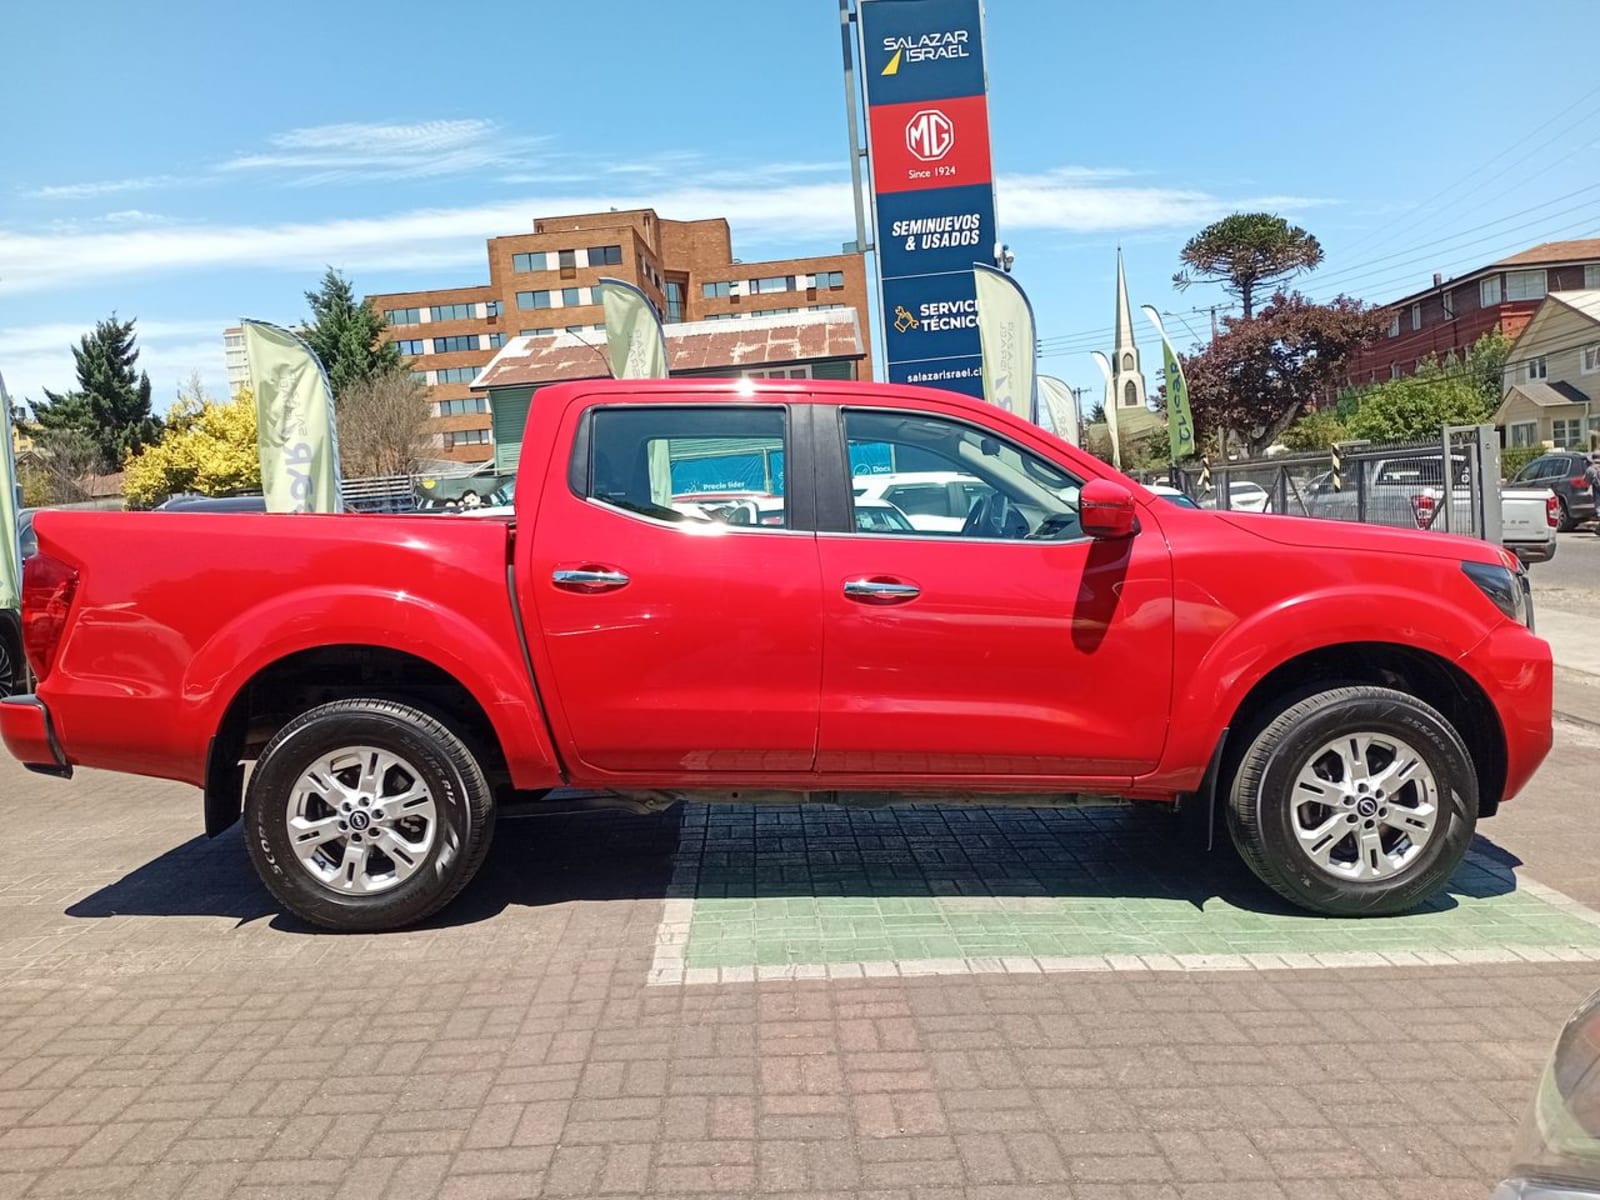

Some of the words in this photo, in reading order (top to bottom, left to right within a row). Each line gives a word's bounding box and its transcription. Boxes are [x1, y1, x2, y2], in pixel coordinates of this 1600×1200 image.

[883, 30, 968, 51] SALAZAR
[905, 45, 969, 62] ISRAEL
[908, 113, 952, 158] MG
[908, 168, 931, 179] Since
[934, 166, 956, 177] 1924
[892, 213, 981, 237] SEMINUEVOS
[905, 237, 916, 251] &
[921, 230, 980, 249] USADOS
[920, 299, 979, 316] SERVICI
[906, 366, 982, 383] salazarisrael.cl
